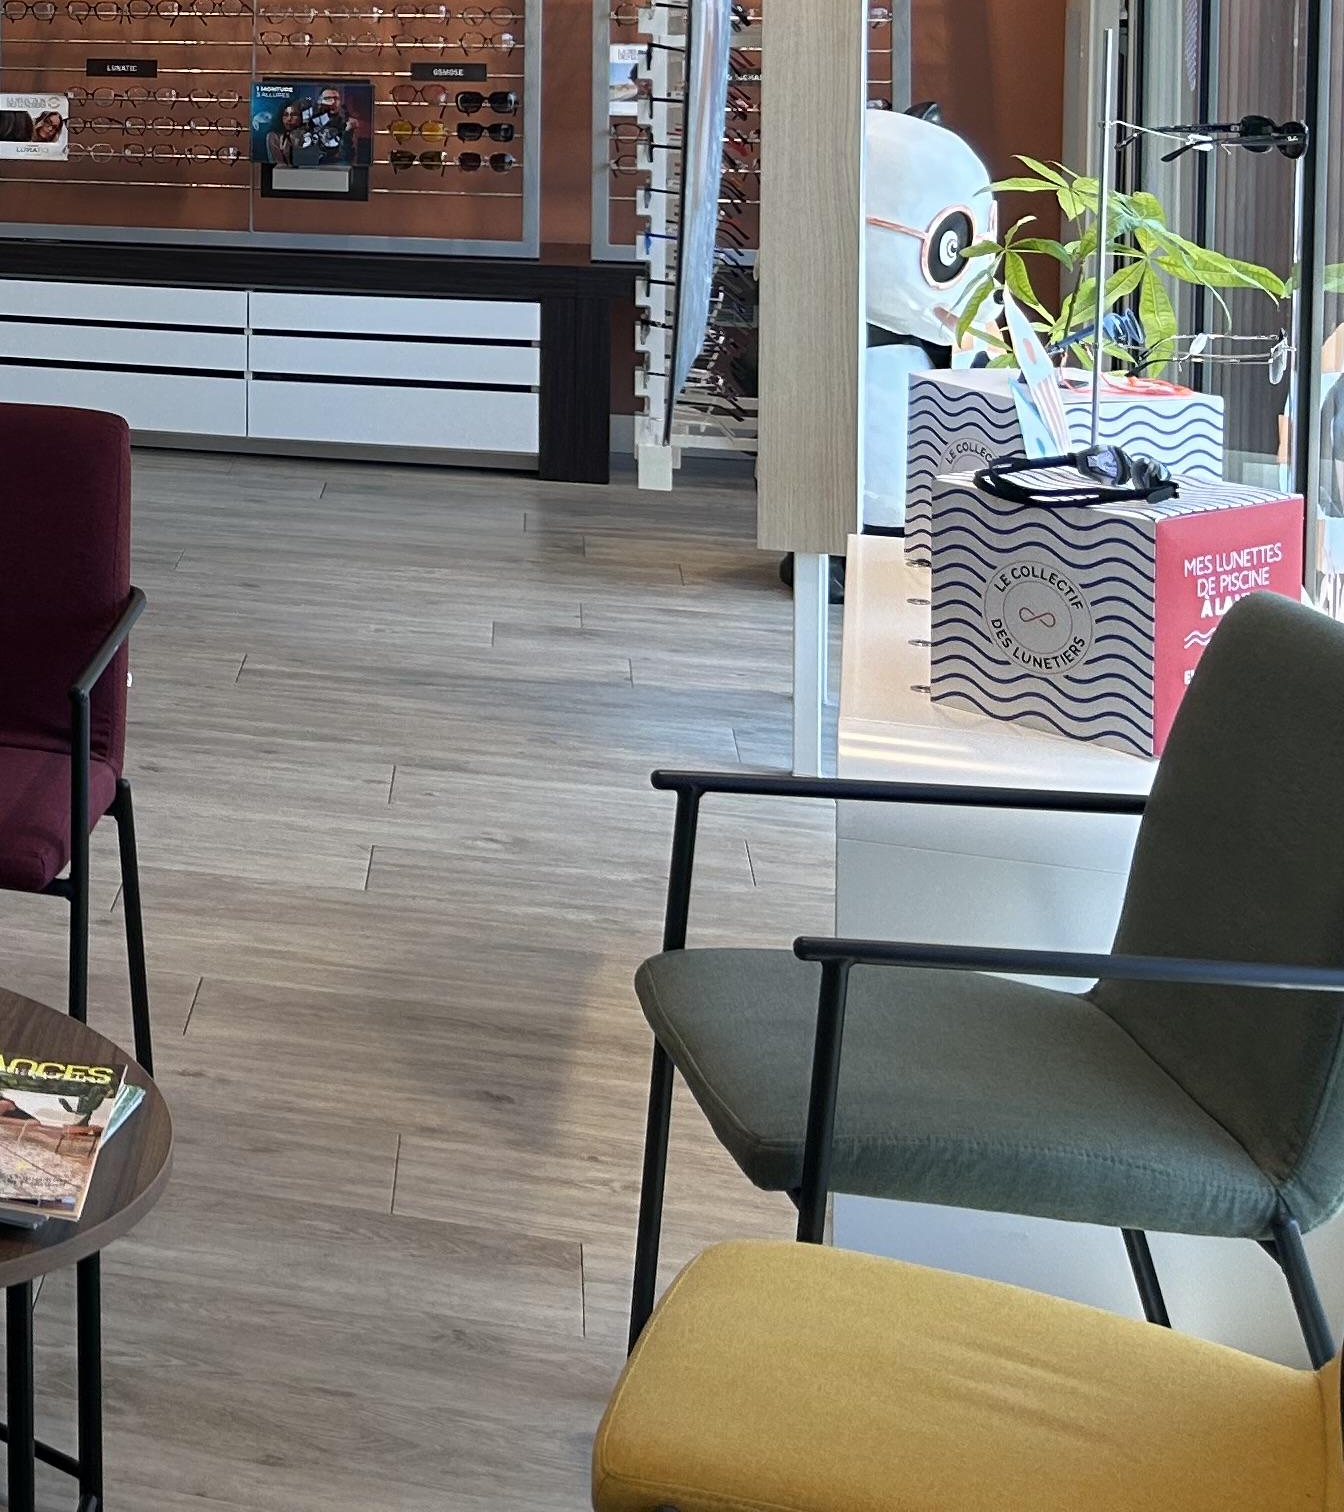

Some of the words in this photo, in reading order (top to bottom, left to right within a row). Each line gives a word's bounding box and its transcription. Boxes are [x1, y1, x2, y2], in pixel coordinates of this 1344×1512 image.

[945, 446, 955, 464] LE
[956, 441, 997, 462] COLLEC
[1184, 555, 1213, 577] MES
[1215, 542, 1282, 573] LUNETTES
[994, 572, 1011, 593] LE
[1010, 564, 1084, 611] COLLECTIF
[1197, 578, 1217, 598] DE
[1220, 566, 1271, 593] PISCINE
[991, 618, 1013, 649] DES
[1013, 636, 1086, 670] LUNETIERS
